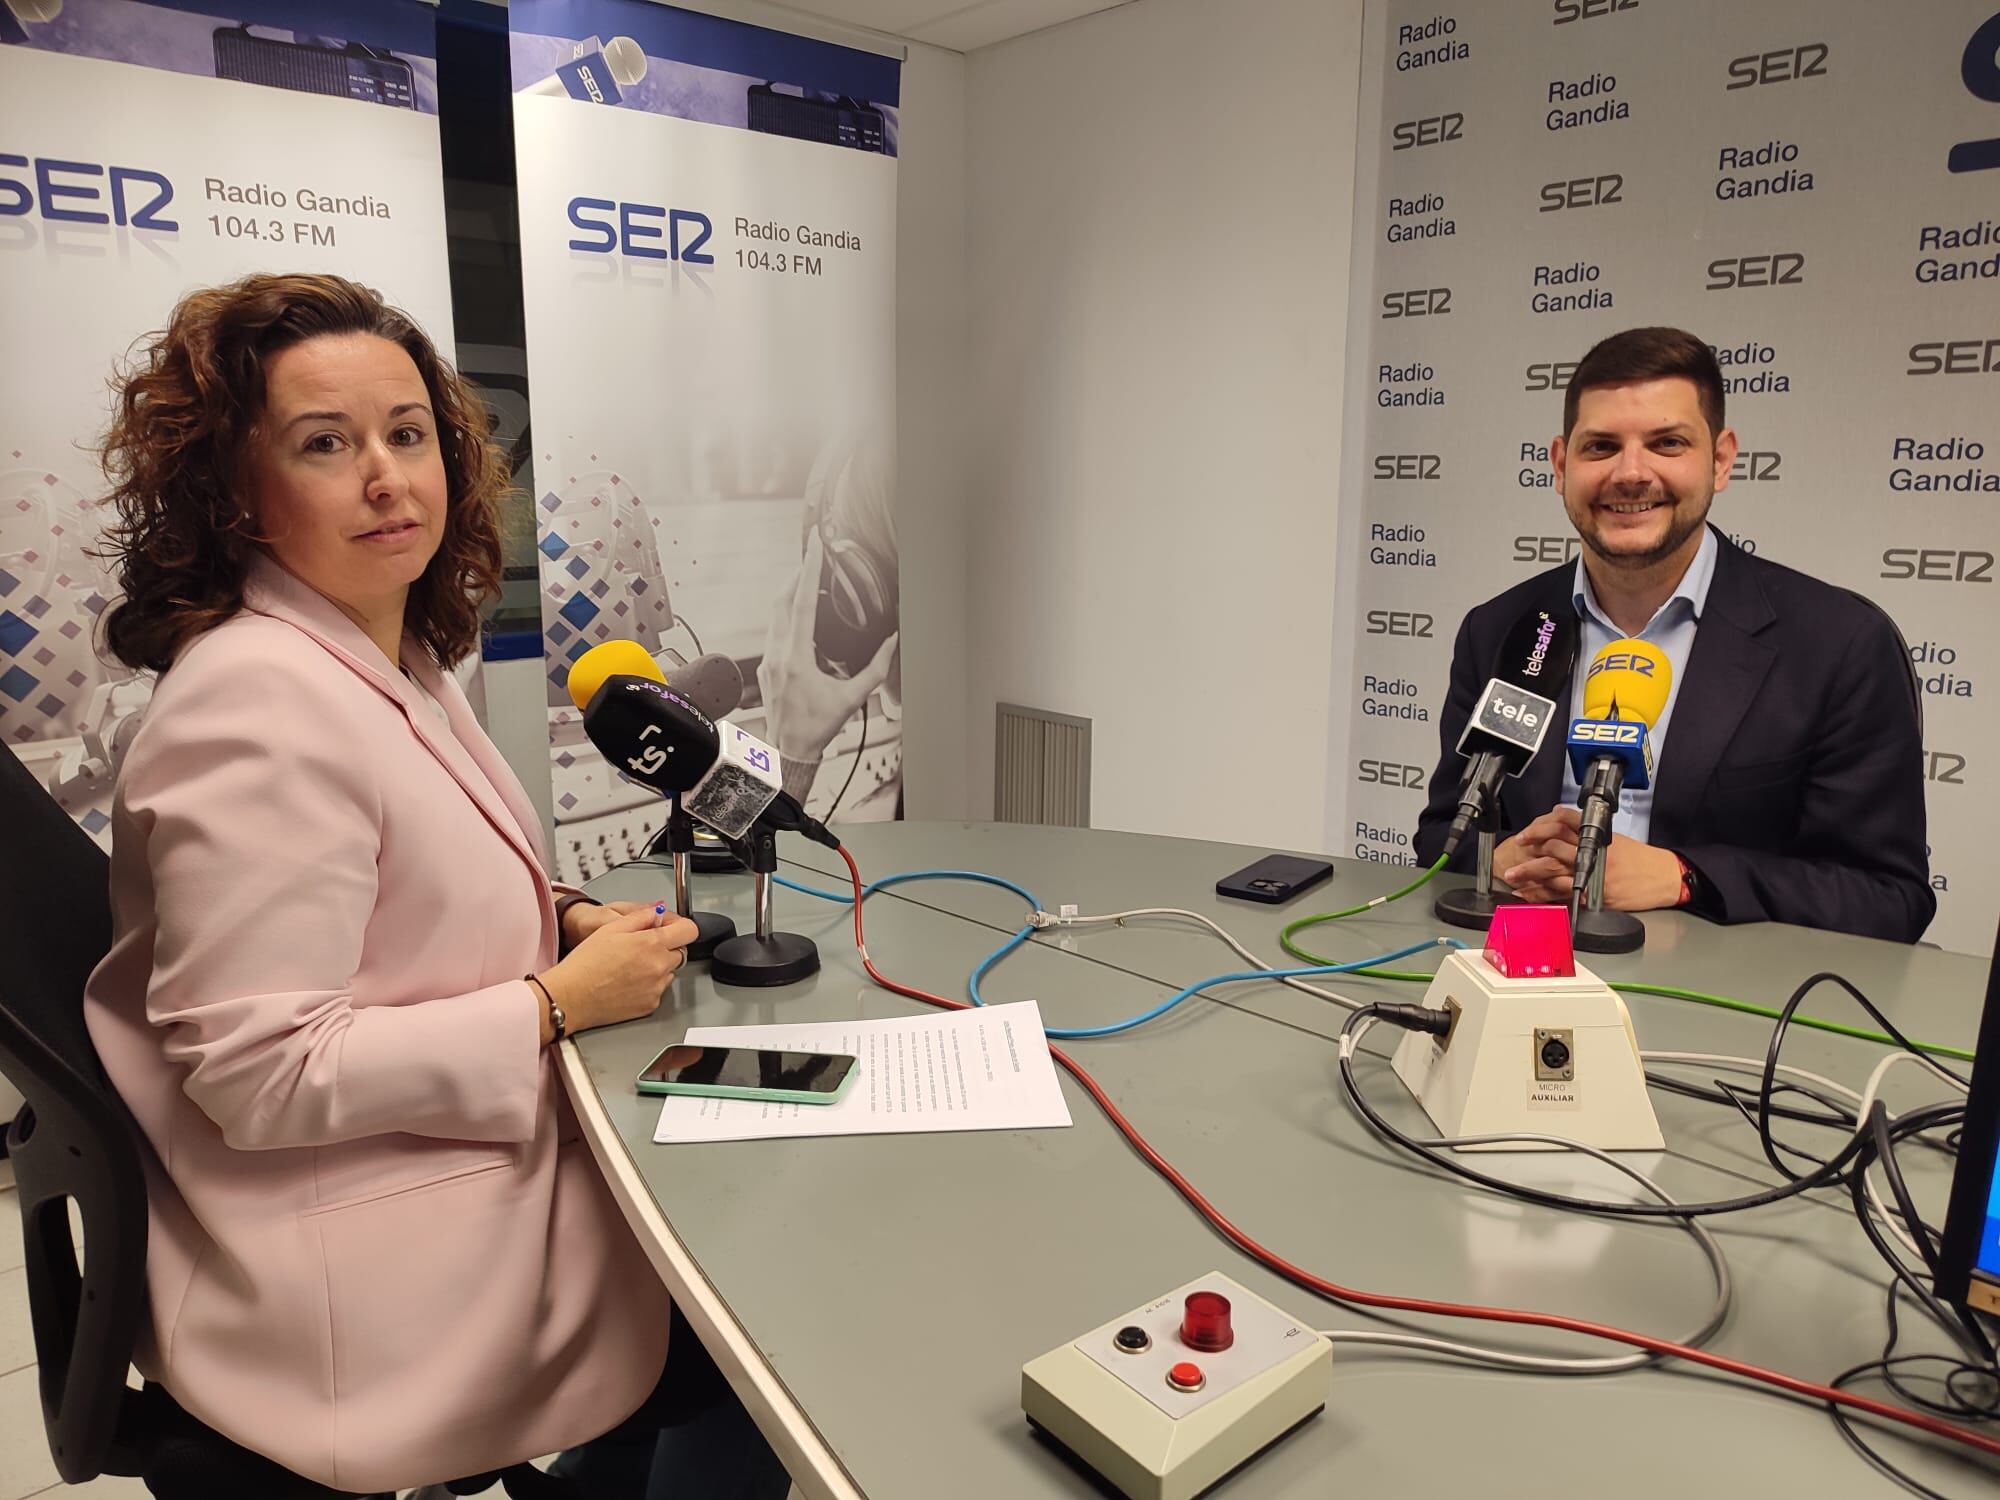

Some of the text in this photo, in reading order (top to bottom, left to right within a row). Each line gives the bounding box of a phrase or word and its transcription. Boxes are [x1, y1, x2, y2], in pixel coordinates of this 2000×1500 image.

[1399, 16, 1457, 45] Radio
[1396, 41, 1470, 71] Gandia
[1726, 43, 1829, 91] SER
[577, 65, 604, 104] SER
[1548, 73, 1616, 103] Radio
[1546, 100, 1630, 131] Gandia
[1393, 112, 1464, 151] SER
[1718, 141, 1799, 170] Radio
[204, 178, 391, 219] Radio Gandia
[1539, 174, 1623, 213] SER
[1715, 169, 1815, 200] Gandia
[1389, 193, 1444, 218] Radio
[208, 215, 336, 248] 104.3 FM
[567, 197, 715, 264] SER
[735, 217, 862, 251] Radio Gandia
[1387, 218, 1456, 243] Gandia
[735, 249, 822, 276] 104.3 FM
[1534, 262, 1600, 287] Radio
[1706, 253, 1805, 290] SER
[1915, 253, 2000, 283] Gand
[1382, 288, 1451, 319] SER
[1531, 288, 1614, 313] Gandia
[1379, 363, 1434, 383] Radio
[1525, 362, 1580, 391] SE
[1721, 371, 1790, 394] andia
[1377, 388, 1445, 408] Gandia
[1893, 437, 1984, 461] Radio
[1374, 455, 1441, 480] SER
[1728, 452, 1781, 480] ER
[1889, 468, 2000, 492] Gandia
[1371, 524, 1426, 543] Radio
[1370, 547, 1437, 567] Gandia
[1880, 549, 1995, 583] SER
[1366, 610, 1434, 639] SER
[1587, 653, 1655, 681] SER
[1909, 641, 1956, 665] dio
[1363, 676, 1418, 698] Radio
[1917, 673, 1973, 697] dia
[1362, 699, 1429, 722] Gandia
[1492, 696, 1538, 727] tele
[1572, 723, 1640, 743] SER
[1358, 759, 1425, 790] SER
[1356, 821, 1408, 846] Radio
[1531, 1094, 1574, 1102] AUXILIAR
[1539, 1084, 1566, 1092] MICRO
